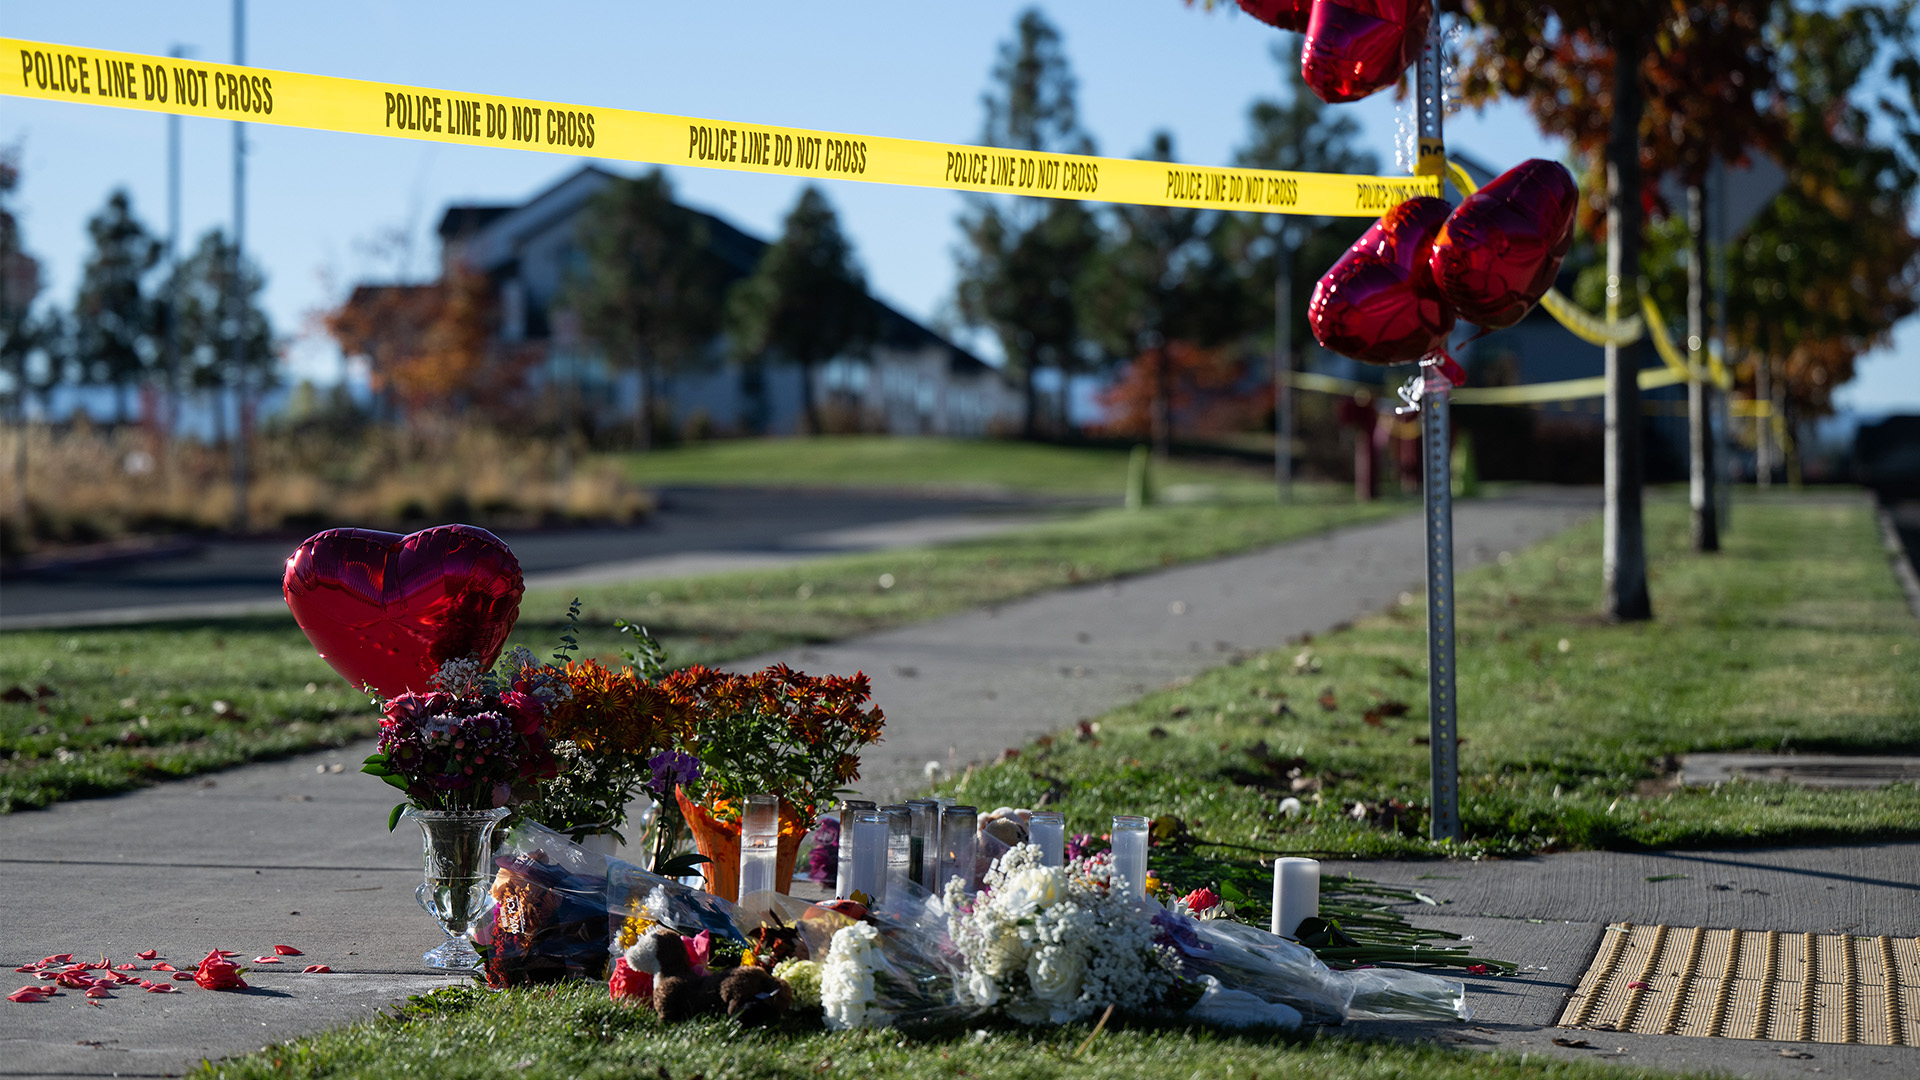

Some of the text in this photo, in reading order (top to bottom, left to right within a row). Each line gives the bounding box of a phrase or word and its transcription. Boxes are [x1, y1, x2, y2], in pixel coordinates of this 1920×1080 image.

[21, 50, 273, 114] POLICE LINE DO NOT CROSS
[385, 92, 595, 148] POLICE LINE DO NOT CROSS
[689, 125, 867, 174] POLICE LINE DO NOT CROSS
[946, 151, 1098, 193] POLICE LINE DO NOT CROSS
[1166, 170, 1297, 205] POLICE LINE DO NOT CROSS
[1356, 183, 1388, 209] POLICE
